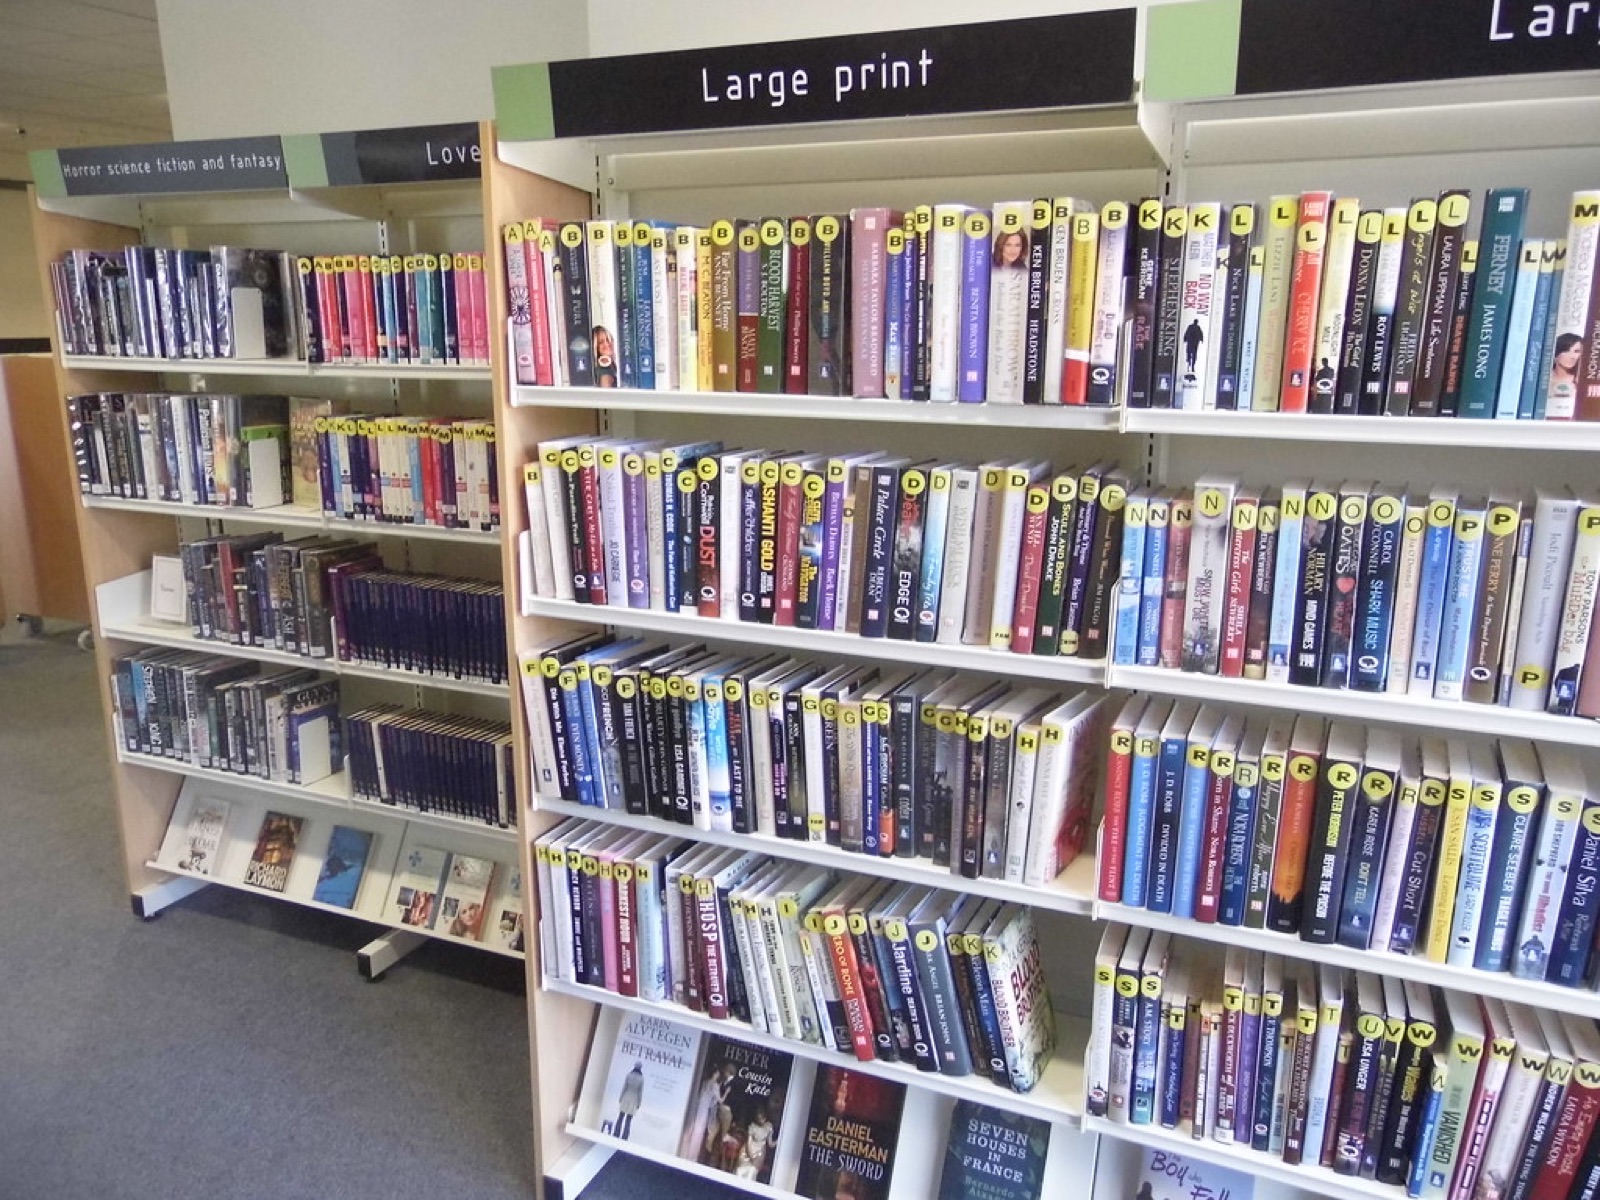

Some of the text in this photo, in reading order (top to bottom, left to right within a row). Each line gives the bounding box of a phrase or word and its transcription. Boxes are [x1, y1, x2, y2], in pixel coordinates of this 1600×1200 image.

[1489, 0, 1600, 46] Lar
[702, 49, 933, 107] Large print
[64, 154, 280, 178] Horror science fiction and fantasy
[427, 142, 481, 165] Love
[871, 242, 879, 285] BARBARA
[1054, 248, 1063, 284] BRUEN
[1440, 236, 1454, 270] LAURA
[722, 252, 731, 332] Far From Home
[768, 249, 780, 331] BLOOD HARVEST
[1164, 257, 1180, 356] STEPHEN KING
[1184, 280, 1198, 309] BACK
[1198, 274, 1212, 317] NO WAY
[1433, 271, 1449, 314] LIPPMAN
[1474, 235, 1512, 379] FERNEY JAMES LONG
[1028, 245, 1043, 382] KEN BRUEN HEADSTONE
[1292, 292, 1312, 354] CHERRY ICE
[870, 325, 878, 376] BRADFORD
[969, 323, 979, 358] BROWN
[1135, 316, 1144, 350] RAGE
[1372, 316, 1387, 372] ROY LEWIS
[665, 473, 674, 503] THOMAS
[873, 489, 889, 560] Palace Circle
[699, 525, 716, 569] DUST
[761, 539, 775, 571] GOLD
[1045, 516, 1060, 581] JOHN DRAKE
[1336, 525, 1353, 574] OATES
[1382, 530, 1394, 565] CAROL
[897, 571, 911, 605] EDGE
[1072, 578, 1081, 600] Brian
[1230, 571, 1241, 593] Girls
[1304, 547, 1316, 595] NORMAN
[1313, 552, 1325, 591] HILARY
[1487, 559, 1501, 594] PERRY
[1192, 577, 1205, 621] MUST DIE
[1365, 579, 1383, 650] SHARK MUSIC
[1576, 570, 1596, 644] TONY PARSONS
[1235, 605, 1244, 635] SHEILA
[1302, 600, 1315, 649] MIND GAMES
[549, 687, 558, 701] Die
[602, 703, 612, 740] FRENCH
[733, 760, 742, 809] LAST TO DIE
[1163, 790, 1173, 813] ROBB
[1209, 806, 1223, 834] Shame
[1366, 806, 1379, 834] KAREN
[1158, 824, 1171, 860] DIVIDED
[1362, 835, 1375, 856] ROSE
[1502, 816, 1525, 893] CLAIRE SEEBER
[1157, 862, 1167, 872] IN
[1404, 851, 1427, 910] Cut Short
[1154, 874, 1165, 903] DEATH
[1316, 854, 1335, 918] BEFORE THE POISON
[1571, 875, 1595, 907] Silva
[892, 942, 916, 995] Jardine
[621, 1041, 685, 1069] BETRAYAL
[725, 1045, 770, 1069] HEYER
[1263, 1025, 1275, 1067] THOMPSON
[1355, 1038, 1374, 1090] LISA UNGER
[738, 1066, 772, 1084] Cousin
[745, 1082, 771, 1096] Kate
[827, 1116, 874, 1142] DANIEL
[968, 1118, 1028, 1146] SEVEN
[1432, 1110, 1461, 1164] VANISHED
[1532, 1112, 1551, 1141] WILSON
[1546, 1096, 1578, 1167] LAURA WILSON
[809, 1128, 888, 1164] EASTERMAN
[809, 1144, 883, 1180] THE SWORD
[967, 1133, 1027, 1159] HOUSES
[987, 1152, 1001, 1162] IN
[963, 1156, 1023, 1183] FRANCE
